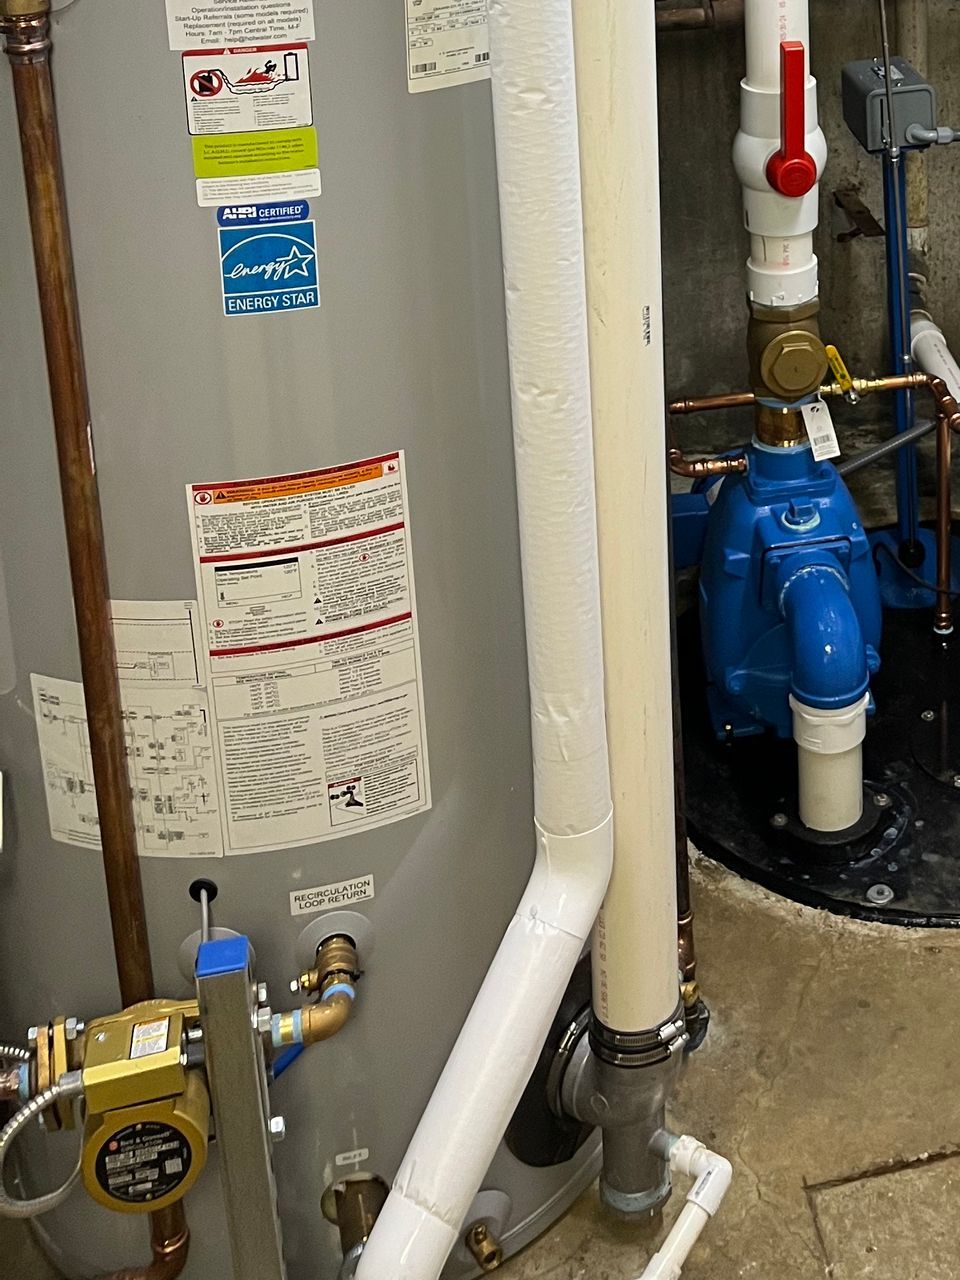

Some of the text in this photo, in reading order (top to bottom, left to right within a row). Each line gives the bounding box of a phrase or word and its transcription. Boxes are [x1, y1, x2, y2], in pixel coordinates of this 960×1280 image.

[260, 1, 291, 11] questions
[174, 7, 309, 23] Start-Up Referrals (some models required)
[183, 22, 226, 30] Replacement
[227, 19, 256, 29] (required
[276, 16, 302, 25] models)
[229, 28, 243, 36] 7pm
[244, 26, 268, 34] Central
[288, 23, 301, 31] M-F
[224, 33, 288, 44] help@hotwater.com
[222, 206, 257, 220] AHRI
[258, 205, 301, 218] CERTIFIED
[224, 258, 298, 281] energy
[228, 291, 315, 311] ENERGY STAR
[294, 879, 371, 903] RECIRCULATION
[299, 888, 367, 910] LOOP RETURN
